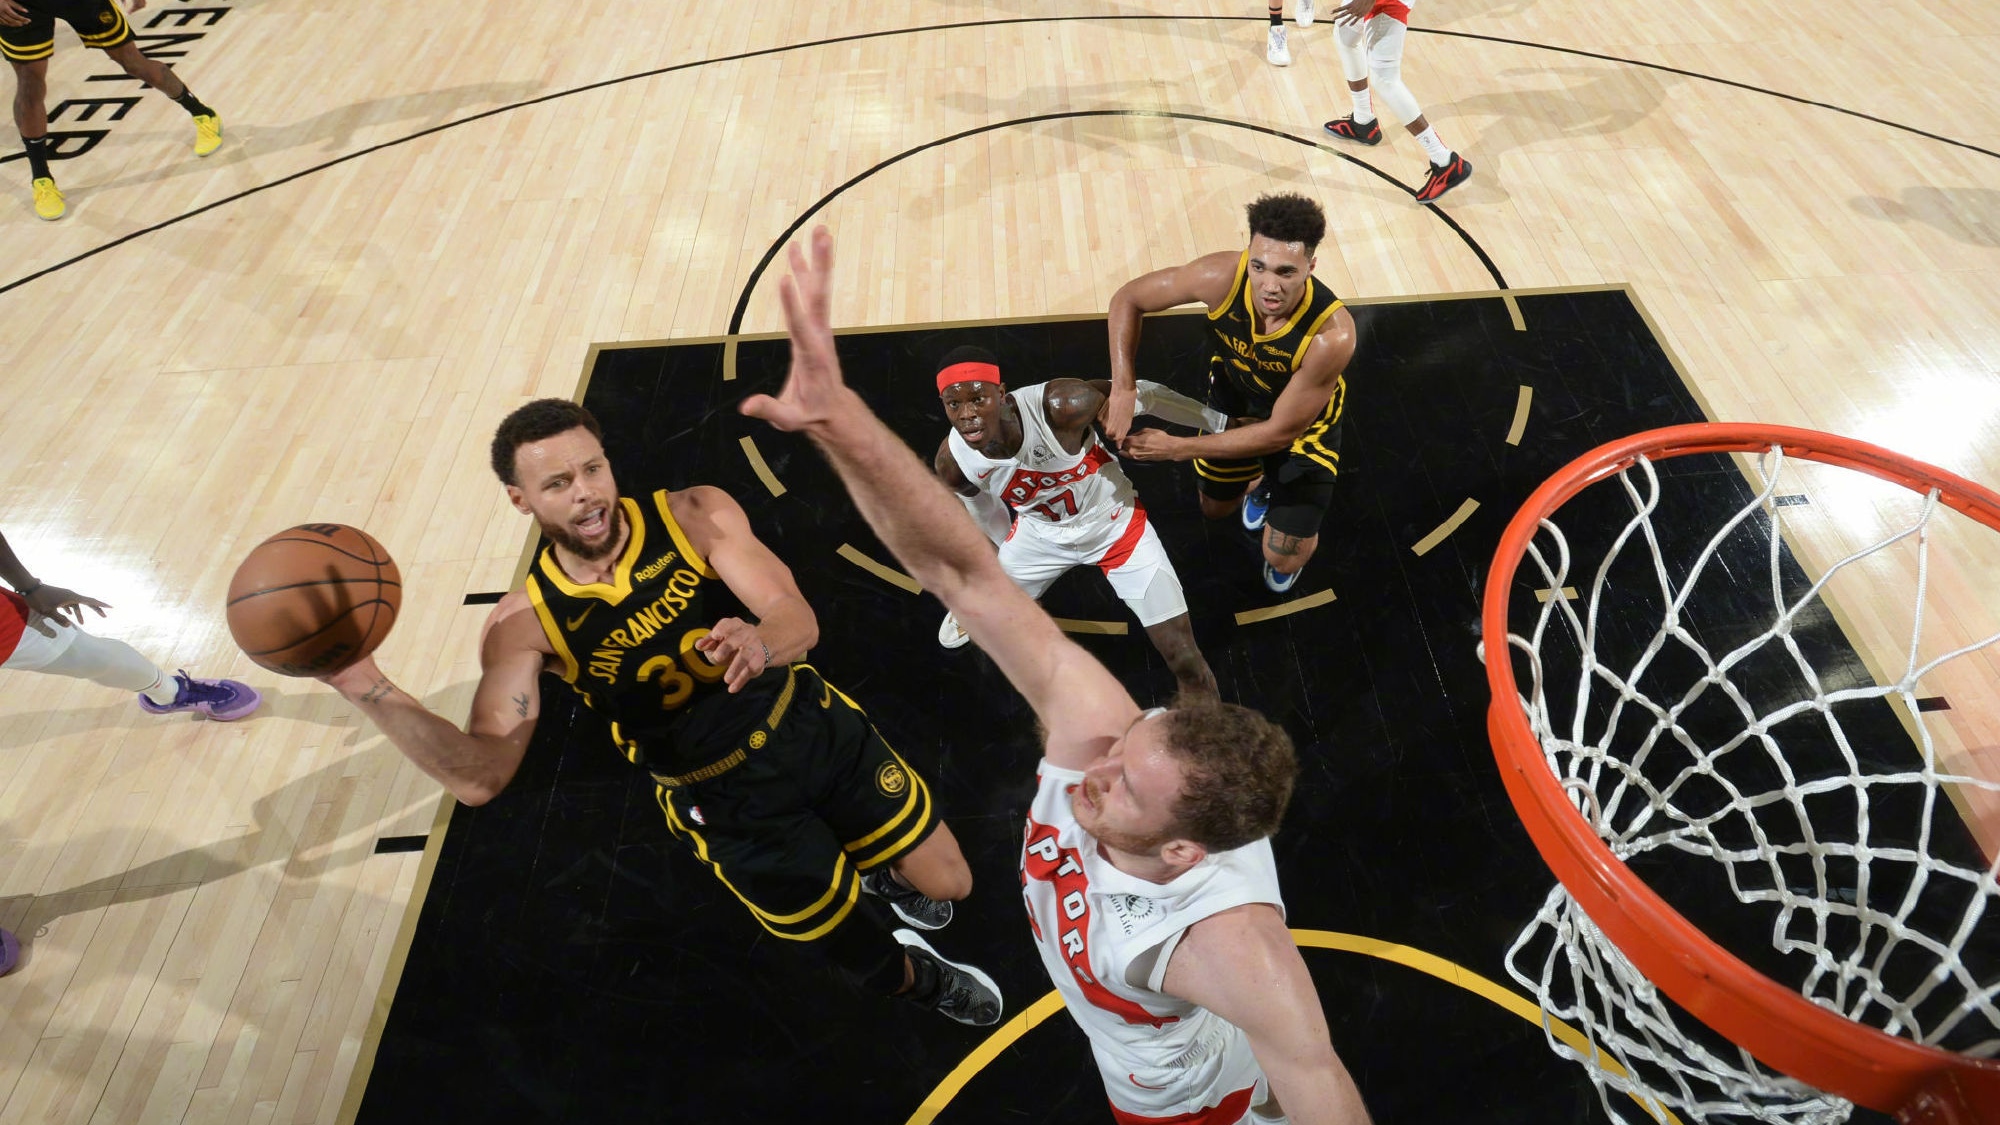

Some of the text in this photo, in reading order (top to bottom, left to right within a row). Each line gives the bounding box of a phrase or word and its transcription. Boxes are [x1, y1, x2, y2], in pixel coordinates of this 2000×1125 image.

[0, 0, 232, 163] ENTER
[1009, 463, 1088, 503] PTORS
[1032, 489, 1079, 521] 17
[634, 551, 677, 582] Rakuten
[588, 649, 624, 685] SAN
[636, 628, 728, 711] 30
[1120, 913, 1134, 935] Life
